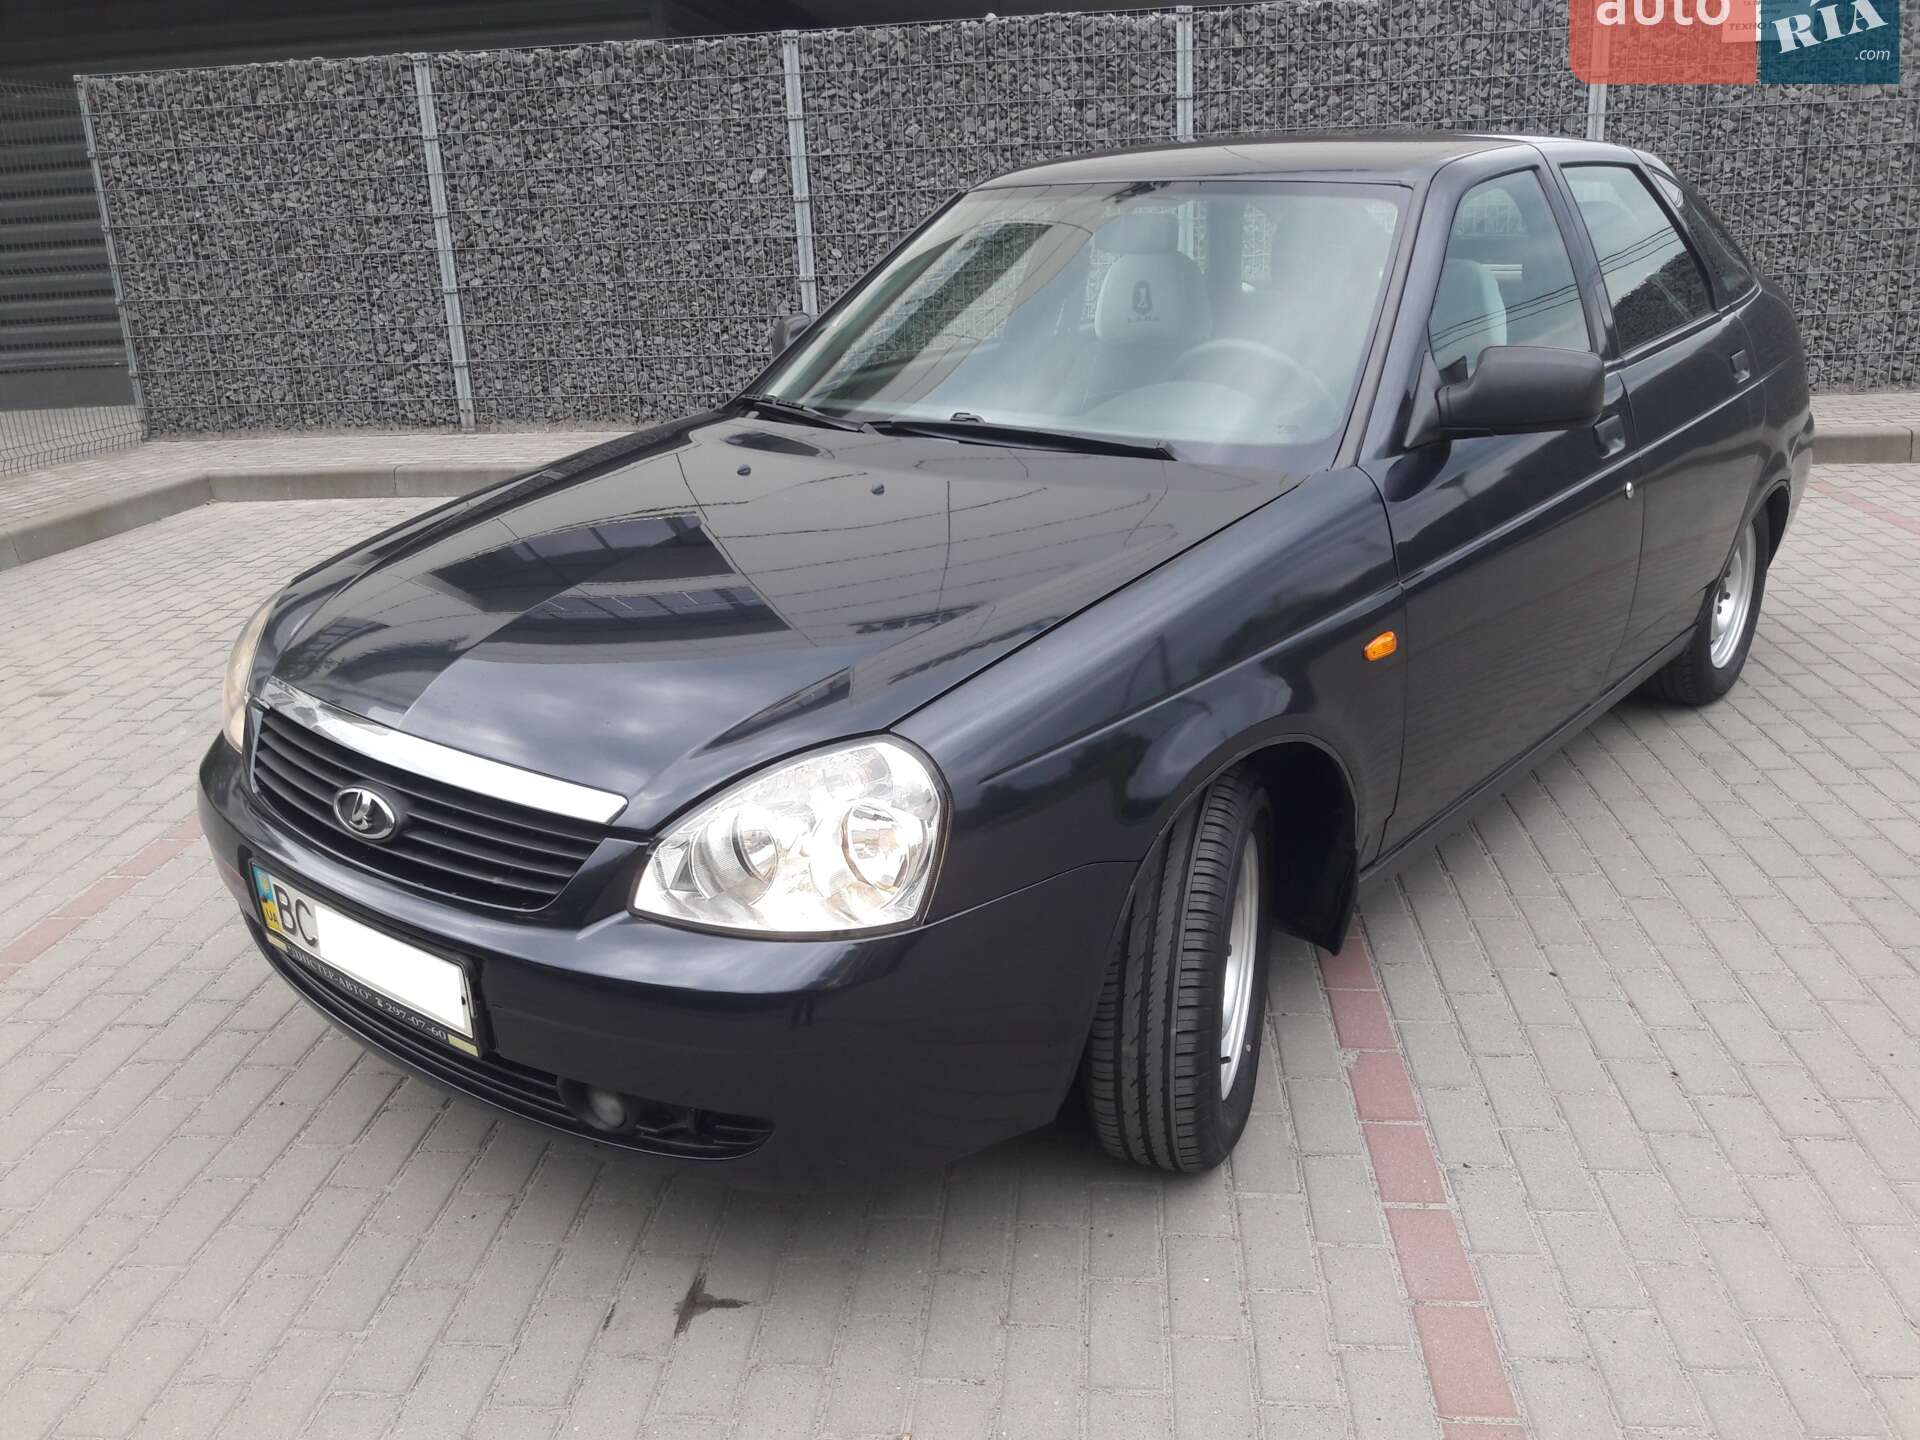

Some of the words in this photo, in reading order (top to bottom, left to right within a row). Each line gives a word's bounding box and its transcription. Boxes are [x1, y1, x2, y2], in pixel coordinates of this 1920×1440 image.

[265, 907, 279, 923] UA
[273, 883, 318, 947] BC
[385, 1002, 447, 1041] 297-07-60
